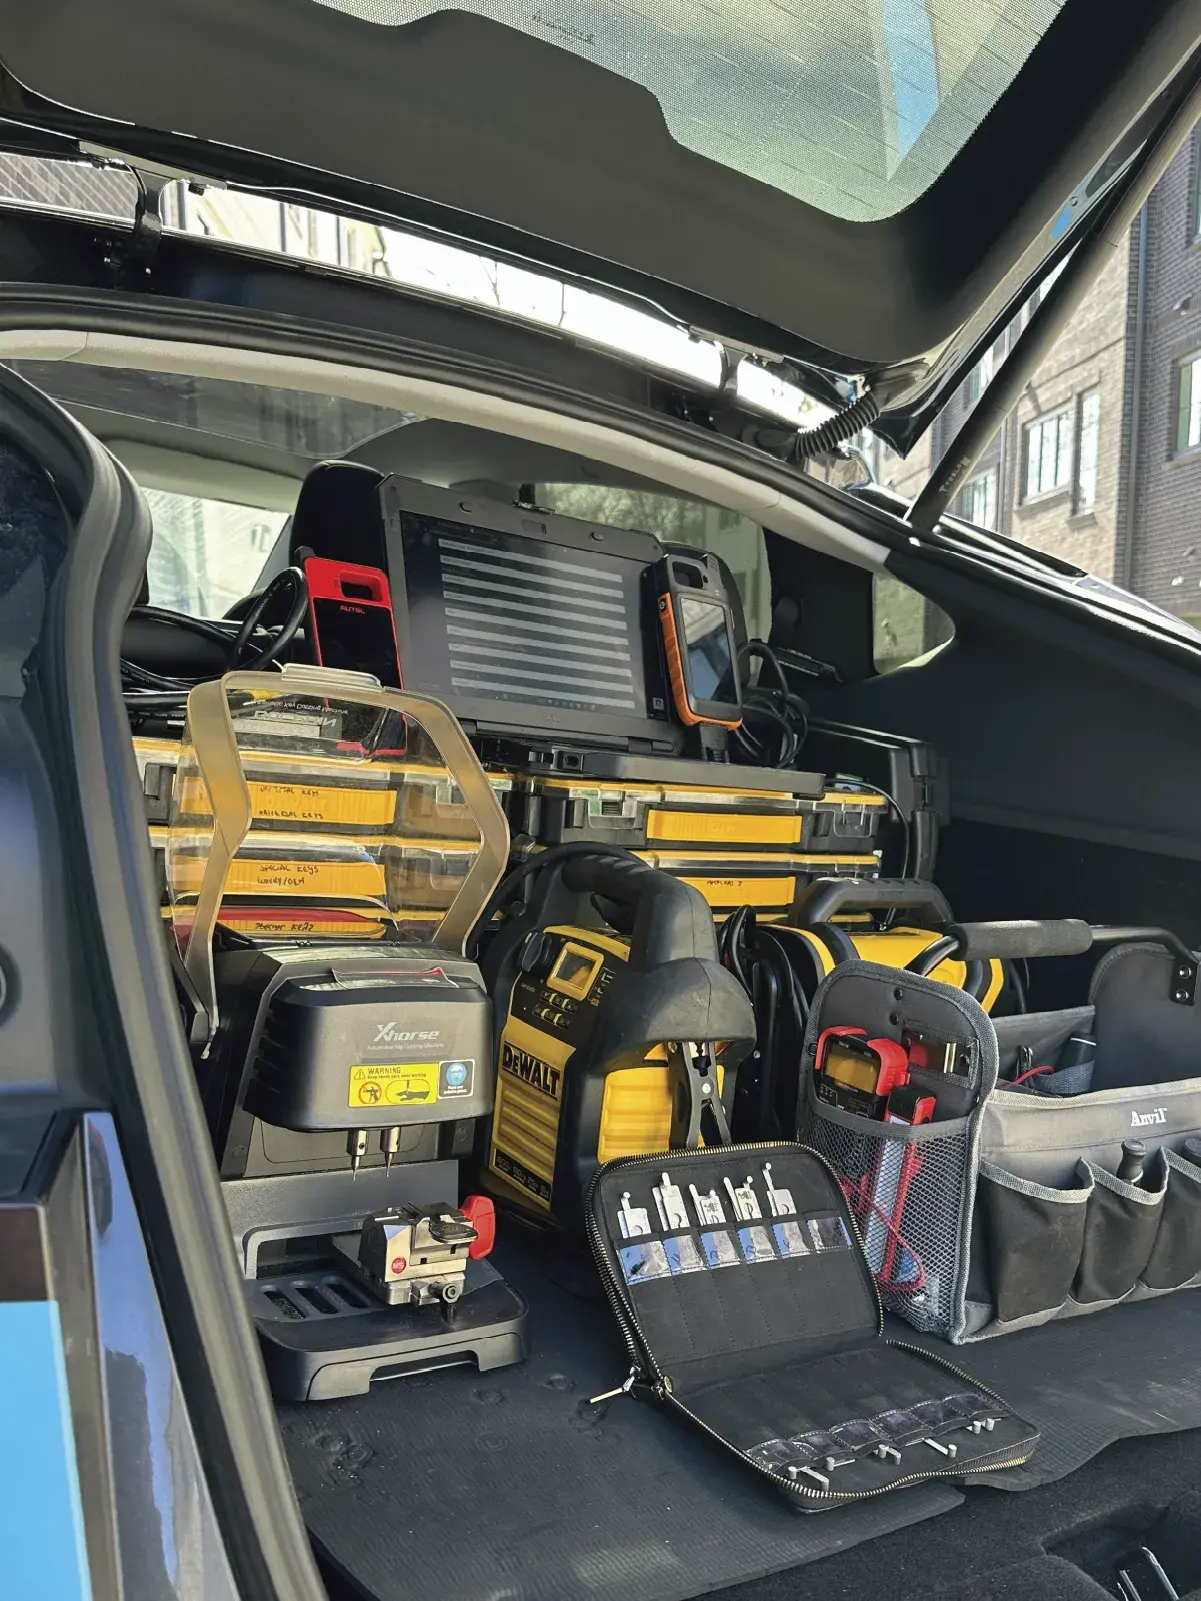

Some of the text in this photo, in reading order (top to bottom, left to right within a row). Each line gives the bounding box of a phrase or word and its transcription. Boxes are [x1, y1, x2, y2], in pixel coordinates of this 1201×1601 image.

[297, 865, 319, 875] KEYS
[373, 1021, 440, 1042] Xhorse
[367, 1066, 402, 1075] WARNING
